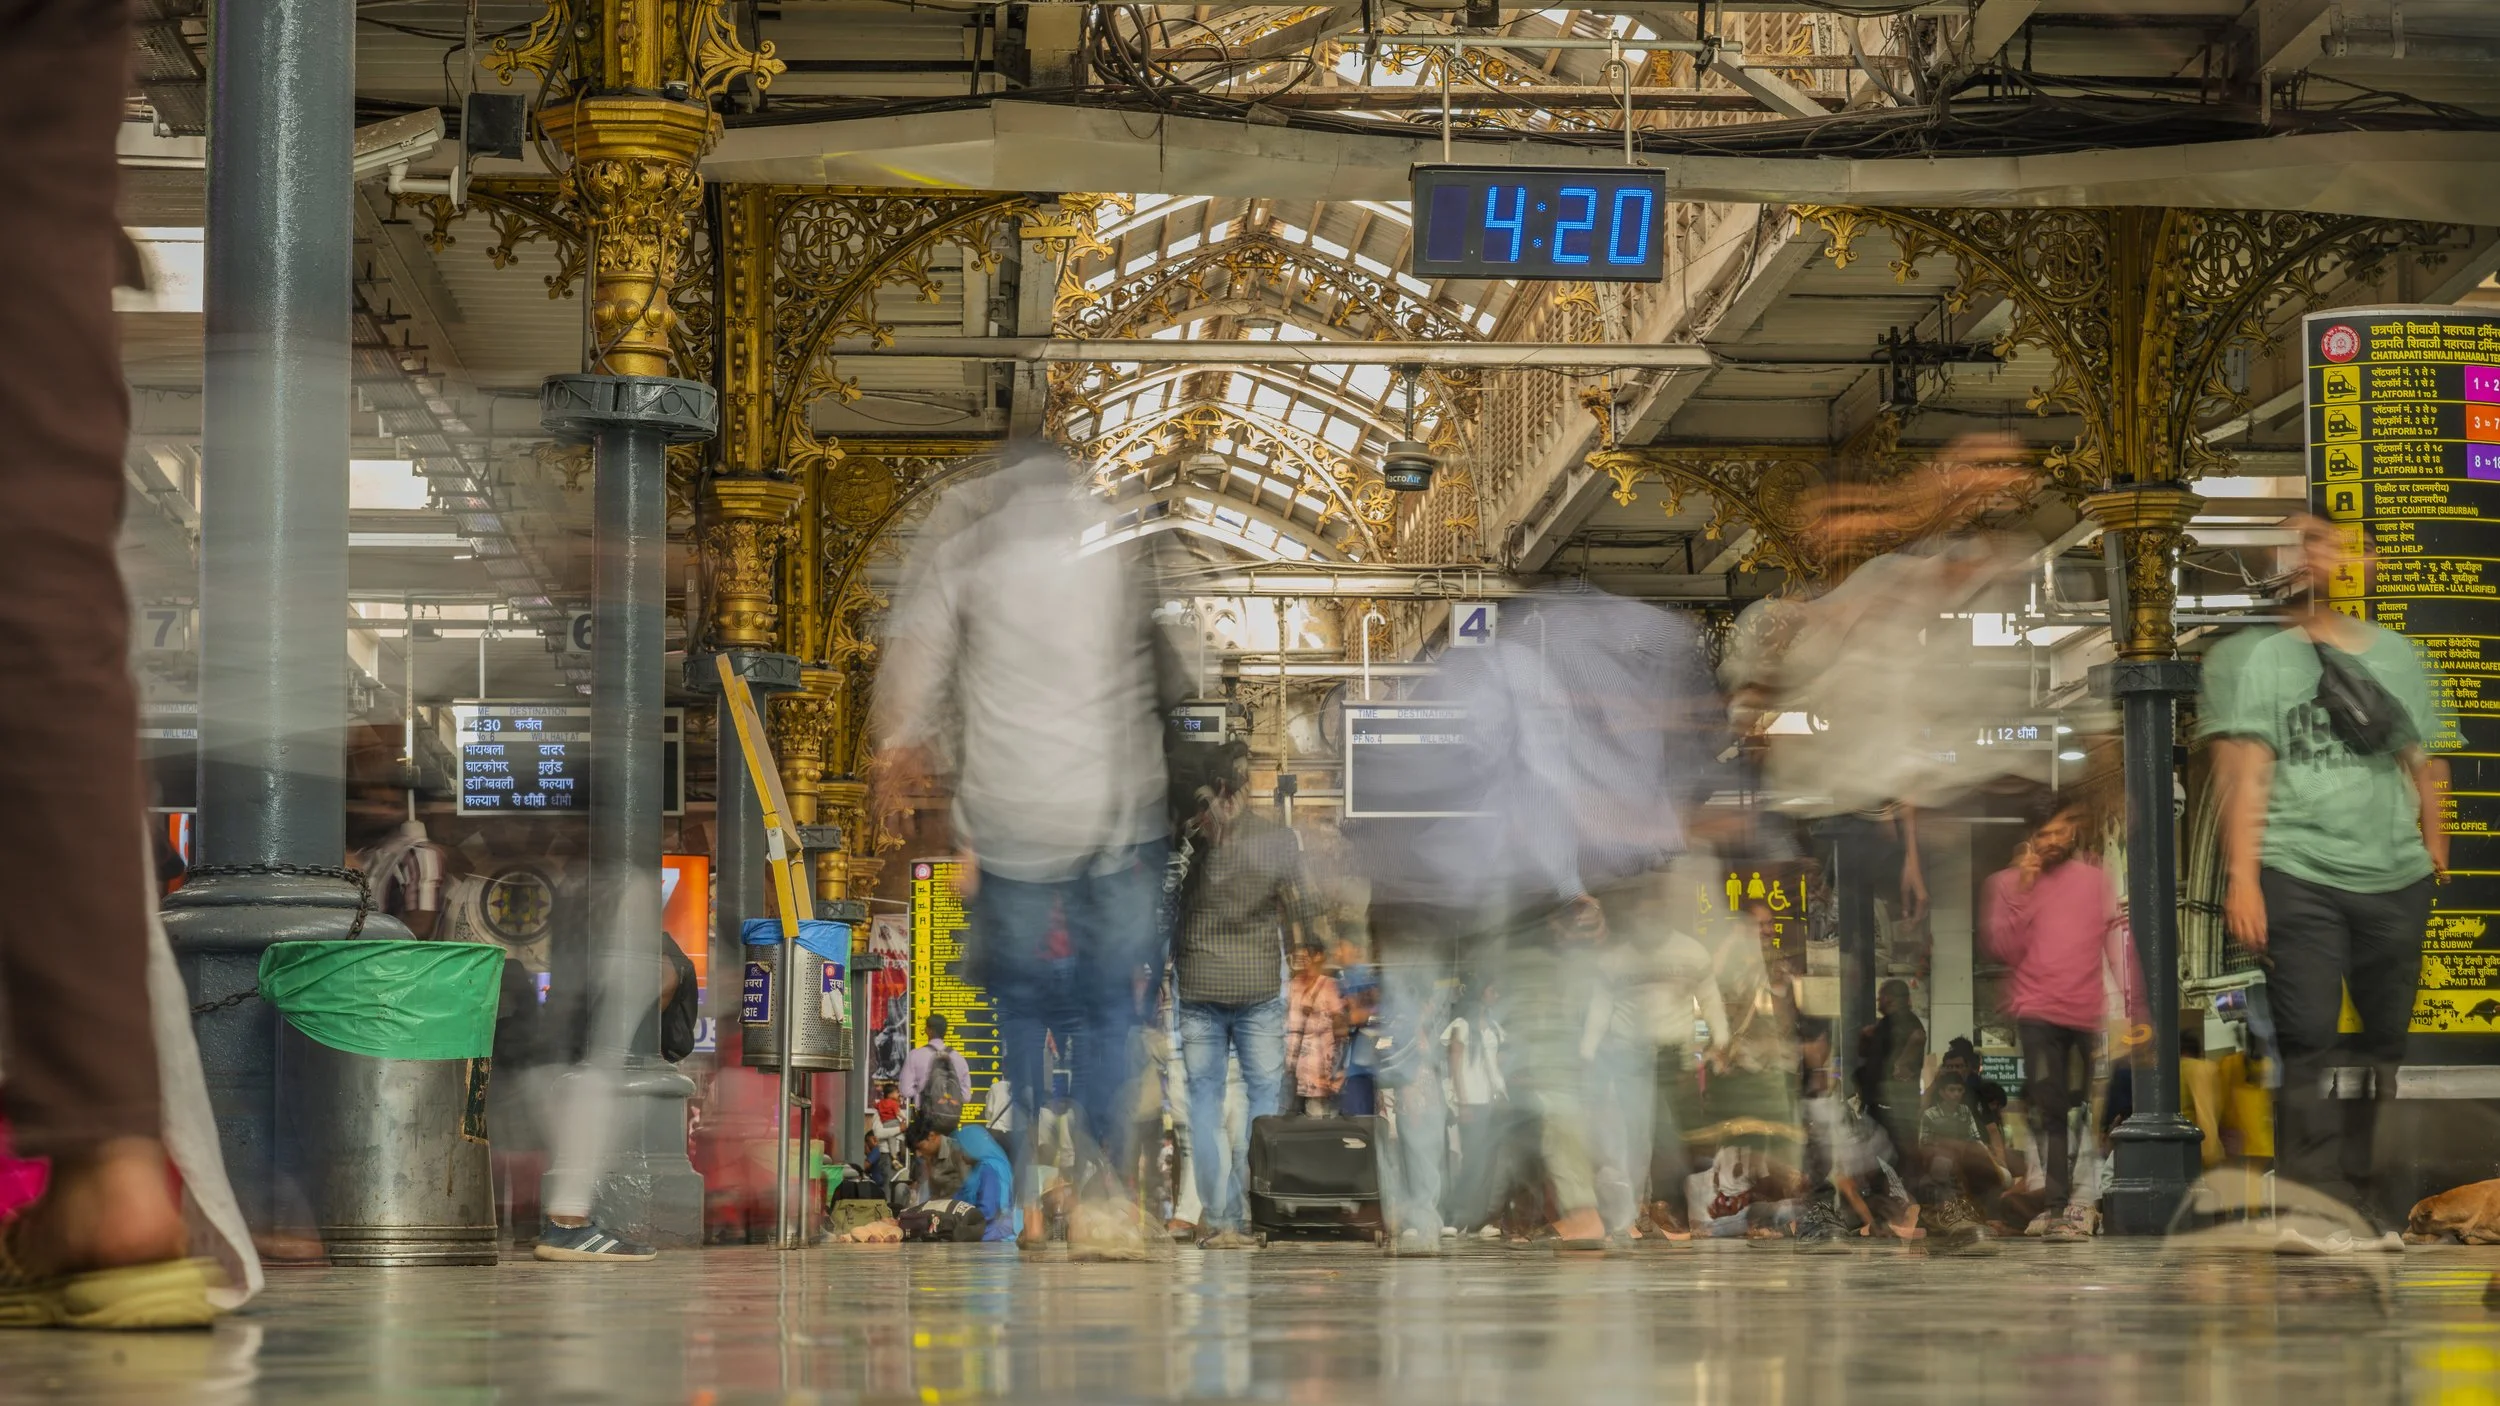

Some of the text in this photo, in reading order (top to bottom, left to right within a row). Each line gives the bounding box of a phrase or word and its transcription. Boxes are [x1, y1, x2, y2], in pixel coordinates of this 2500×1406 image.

[1484, 186, 1652, 264] 4:20
[2370, 322, 2404, 335] छत्रपति
[2406, 322, 2440, 335] शिवाजी
[2443, 325, 2475, 336] महाराज
[2371, 336, 2404, 349] छत्रपति
[2407, 336, 2441, 349] शिवाजी
[2443, 339, 2476, 350] महाराज
[2371, 350, 2489, 362] CHATRAPATI SHIVAJI MAHARAJ
[2473, 377, 2479, 390] 1
[2493, 379, 2500, 391] 2
[2371, 390, 2415, 398] PLATFORM
[2417, 390, 2421, 398] 1
[2432, 390, 2438, 398] 2
[2474, 416, 2480, 429] 3
[2494, 418, 2500, 430] 7
[2372, 428, 2416, 436] PLATFORM
[2432, 455, 2440, 463] 18
[2474, 455, 2481, 468] 8
[2373, 466, 2417, 474] PLATFORM
[2419, 466, 2424, 474] 8
[2435, 466, 2444, 474] 18
[2375, 506, 2478, 517] TICKET COUNTER (SUBURBAN)
[2375, 545, 2423, 554] CHILD HELP
[2376, 584, 2415, 593] DRINKING
[2417, 584, 2444, 592] WATER
[2465, 585, 2496, 594] PURIFIED
[147, 611, 176, 647] 7
[1459, 608, 1490, 644] 4
[2433, 661, 2480, 670] & JAN AAHAR
[2441, 700, 2463, 708] STALL
[509, 707, 567, 715] DESTINATION
[1358, 709, 1378, 718] TIME
[468, 719, 501, 731] 4:30
[514, 717, 543, 731] कर्जत
[1184, 717, 1202, 731] तेज
[181, 729, 197, 738] HAL
[531, 732, 580, 740] WILL HALT AT
[2017, 726, 2038, 740] धीमी
[465, 744, 504, 756] भायखला
[538, 744, 565, 756] दादर
[2430, 740, 2462, 749] LOUNGE
[465, 759, 509, 773] घाटकोपर
[538, 778, 574, 790] कल्याण
[465, 795, 500, 807] कल्याण
[2461, 822, 2488, 831] OFFICE
[2433, 941, 2473, 949] & SUBWAY
[2450, 978, 2468, 986] PAID
[2469, 978, 2486, 986] TAXI
